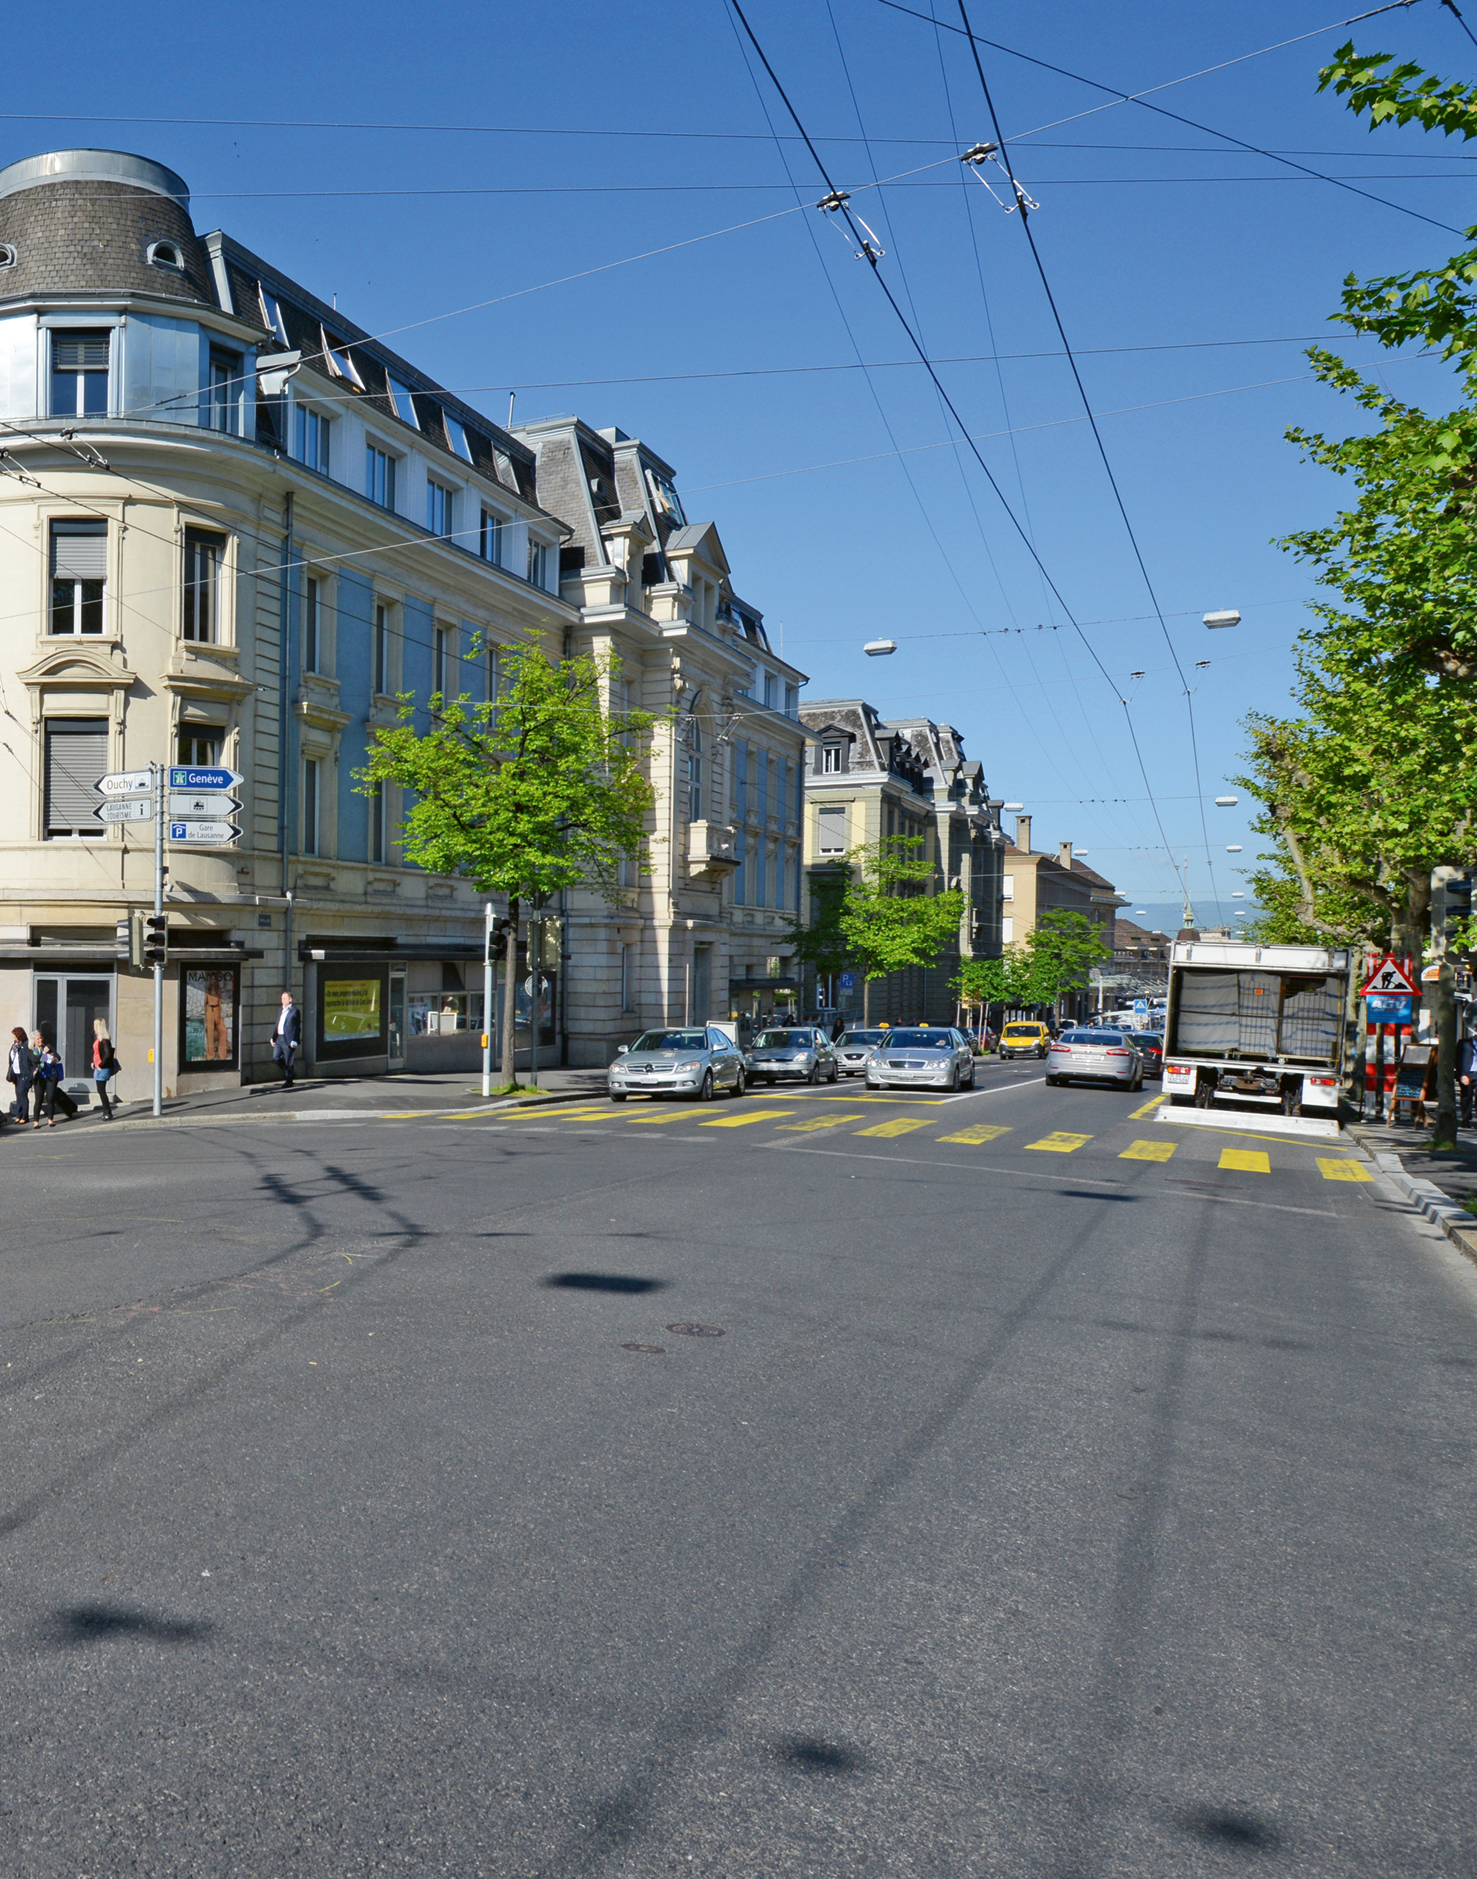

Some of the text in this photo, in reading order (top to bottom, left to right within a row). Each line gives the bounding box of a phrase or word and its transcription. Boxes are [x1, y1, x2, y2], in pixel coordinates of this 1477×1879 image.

[188, 773, 224, 784] Genève
[106, 779, 134, 791] Ouchy
[106, 802, 132, 812] LAUSANNE
[107, 810, 132, 820] TOURISME
[199, 824, 214, 832] Gare
[196, 831, 225, 839] Lausanne
[1371, 1000, 1407, 1009] AGV
